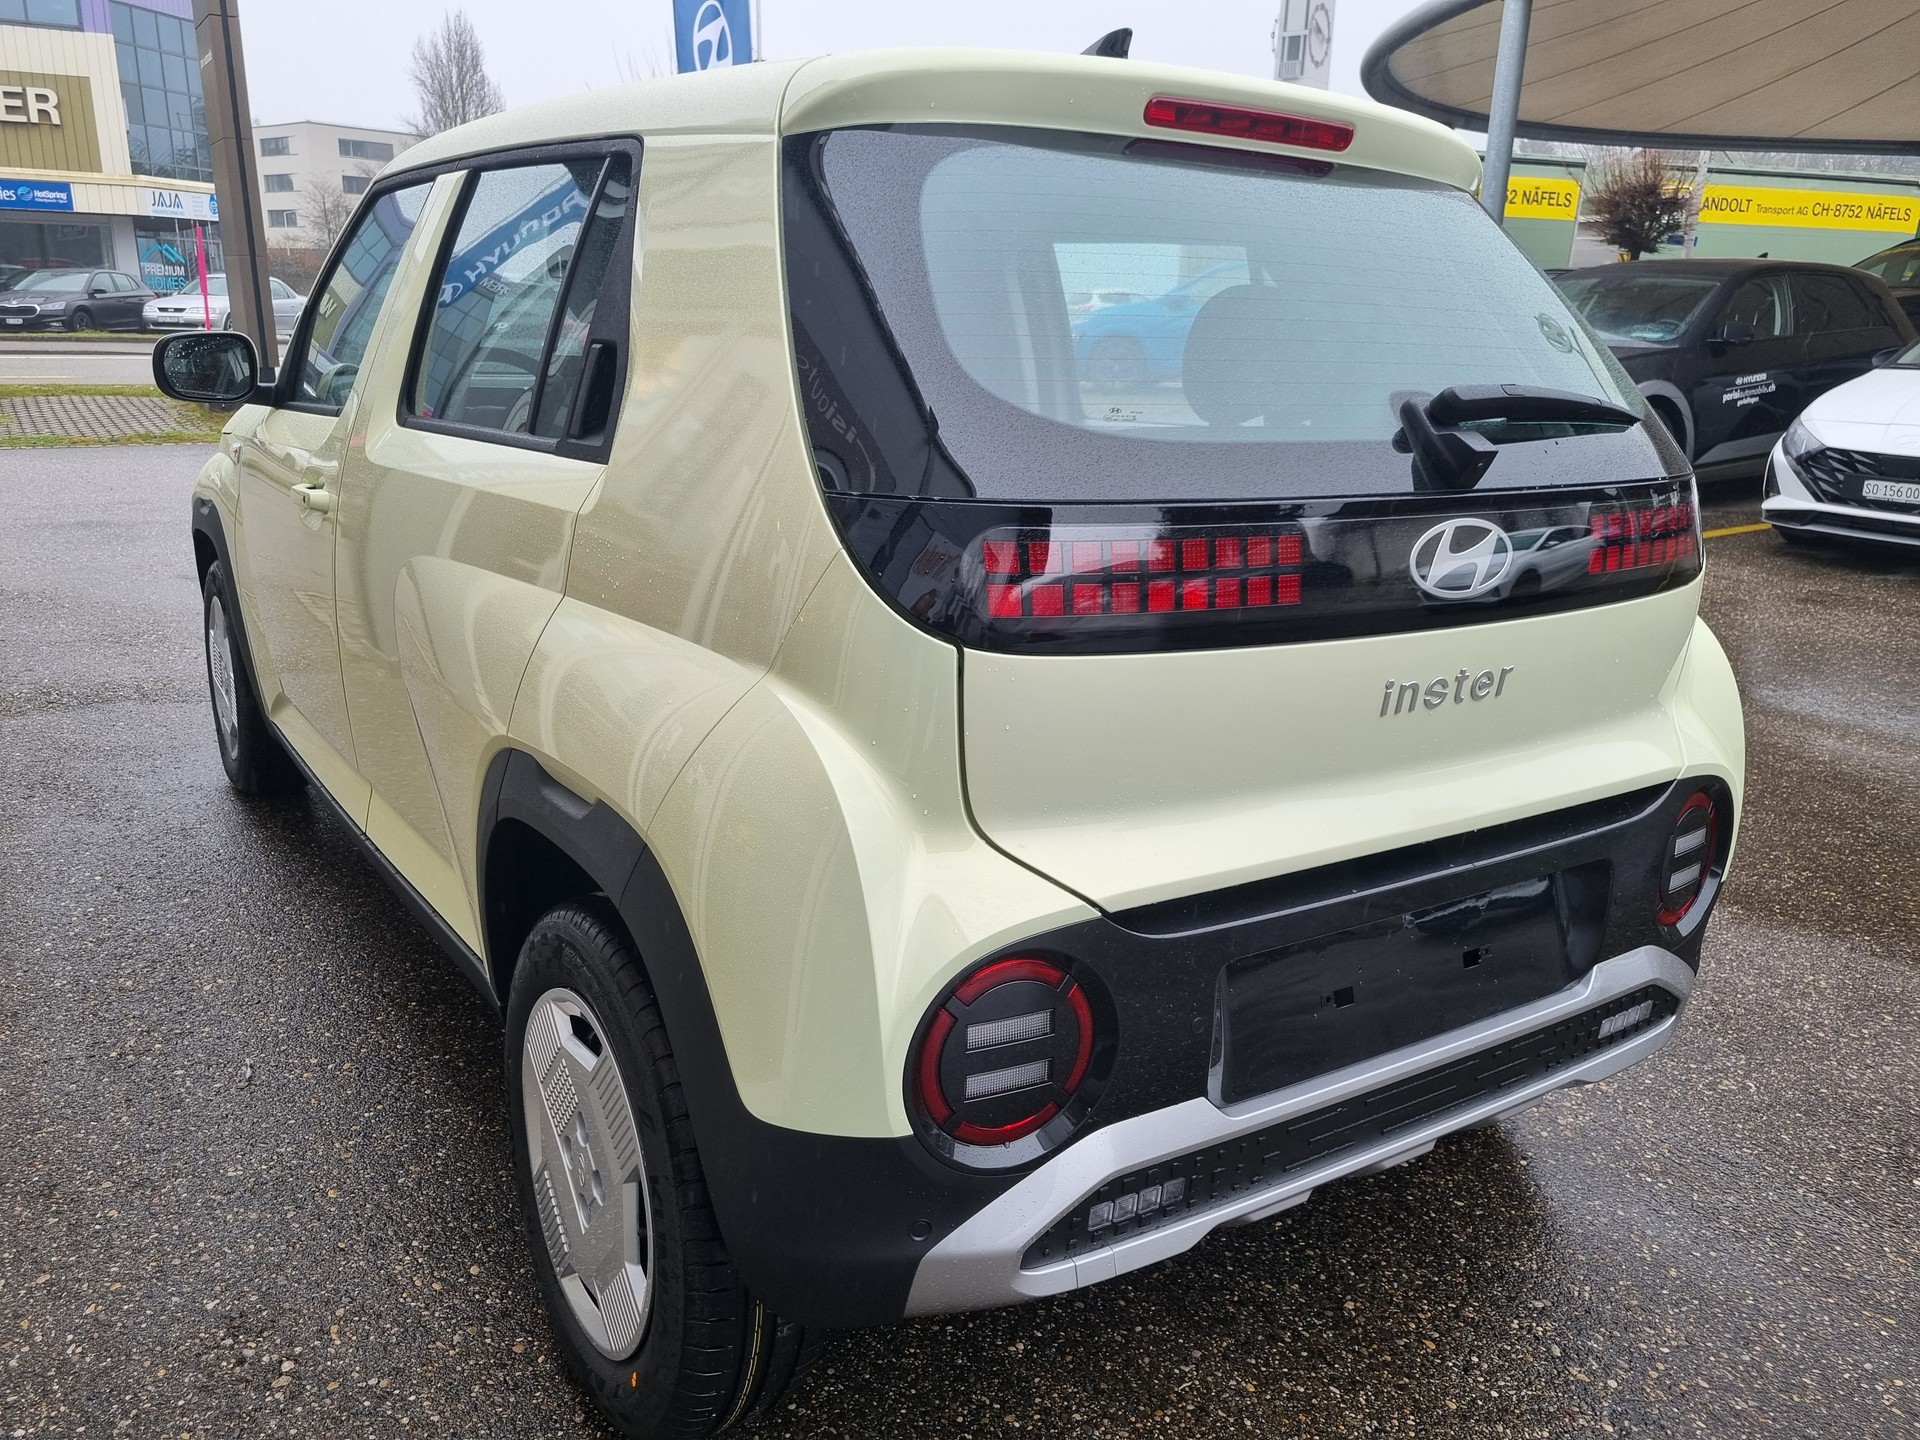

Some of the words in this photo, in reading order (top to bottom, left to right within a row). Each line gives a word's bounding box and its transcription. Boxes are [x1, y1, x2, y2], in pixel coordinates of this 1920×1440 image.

[0, 85, 61, 126] ER
[34, 189, 68, 200] HotSpring
[152, 190, 184, 210] JAJA
[1521, 186, 1573, 208] NÄFELS
[1756, 203, 1795, 217] Transport
[1796, 206, 1809, 216] AG
[1812, 202, 1863, 219] CH-8752
[1865, 203, 1912, 222] NÄFELS
[144, 264, 186, 276] PREMIUM
[146, 277, 187, 291] HOMES
[1379, 664, 1515, 718] inster
